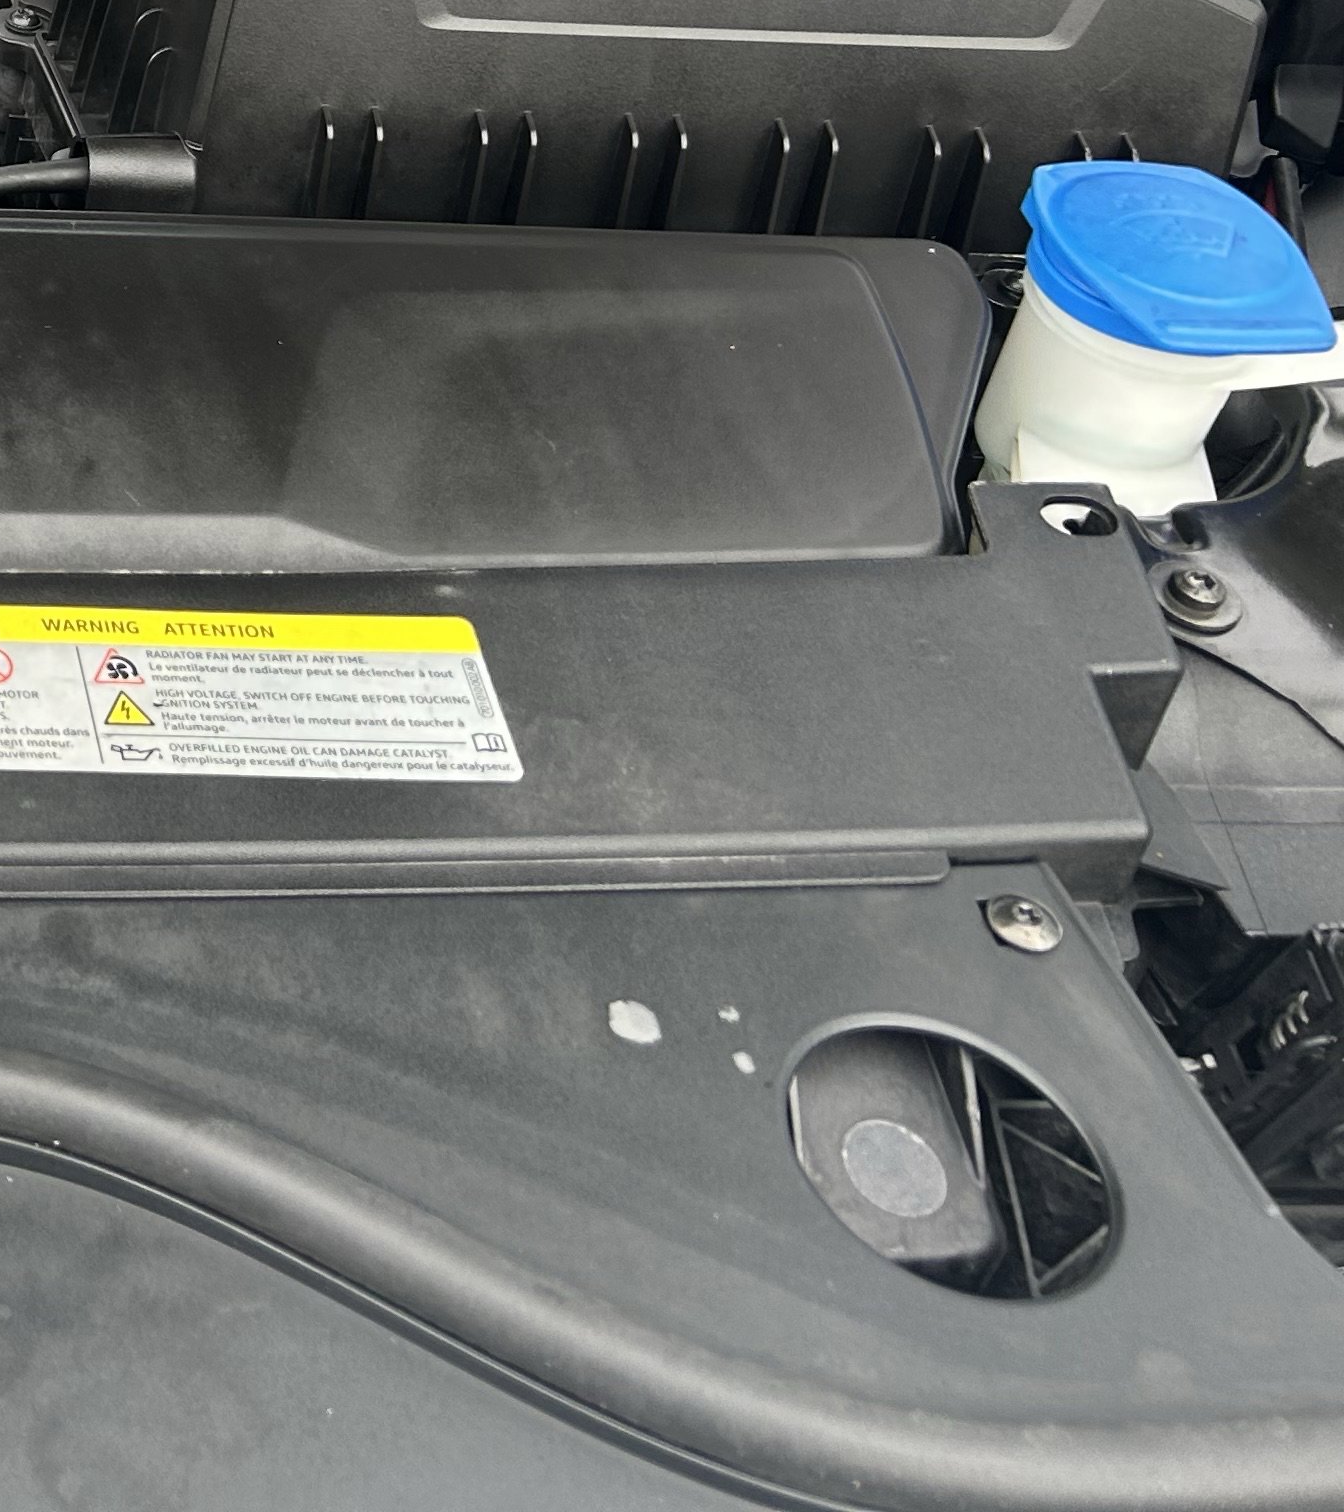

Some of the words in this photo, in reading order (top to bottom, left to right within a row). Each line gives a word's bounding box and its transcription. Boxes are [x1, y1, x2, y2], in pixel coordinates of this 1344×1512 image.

[41, 617, 140, 635] WARNING
[164, 623, 274, 638] ATTENTION
[146, 650, 203, 660] RADIATOR
[207, 650, 228, 660] FAN
[232, 651, 255, 661] MAY
[259, 652, 292, 662] START
[297, 654, 309, 663] AT
[312, 654, 335, 664] ANY
[149, 662, 163, 671] Le
[165, 663, 228, 673] ventilateur
[232, 664, 246, 674] de
[250, 665, 302, 675] radiateur
[306, 666, 334, 677] peut
[352, 668, 415, 677] déclencher
[419, 669, 425, 677] à
[429, 670, 453, 678] tout
[156, 689, 184, 698] HIGH
[244, 691, 287, 700] SWITCH
[291, 692, 311, 701] OFF
[316, 693, 358, 703] ENGINE
[362, 694, 407, 703] BEFORE
[410, 696, 470, 705] TOUCHING
[158, 700, 210, 709] GNITION
[162, 712, 196, 721] Haute
[252, 713, 290, 724] arrêter
[294, 715, 304, 724] le
[308, 716, 350, 725] moteur
[355, 718, 388, 726] avant
[391, 718, 405, 727] de
[409, 718, 454, 727] toucher
[458, 719, 465, 727] à
[20, 726, 60, 737] chauds
[63, 727, 89, 737] dans
[169, 743, 240, 753] OVERFILLED
[244, 745, 287, 755] ENGINE
[291, 746, 310, 755] OIL
[313, 746, 336, 756] CAN
[340, 748, 389, 757] DAMAGE
[172, 755, 246, 767] Remplissage
[250, 755, 296, 766] excessif
[342, 759, 403, 771] dangereux
[407, 762, 433, 771] pour
[437, 760, 447, 770] le
